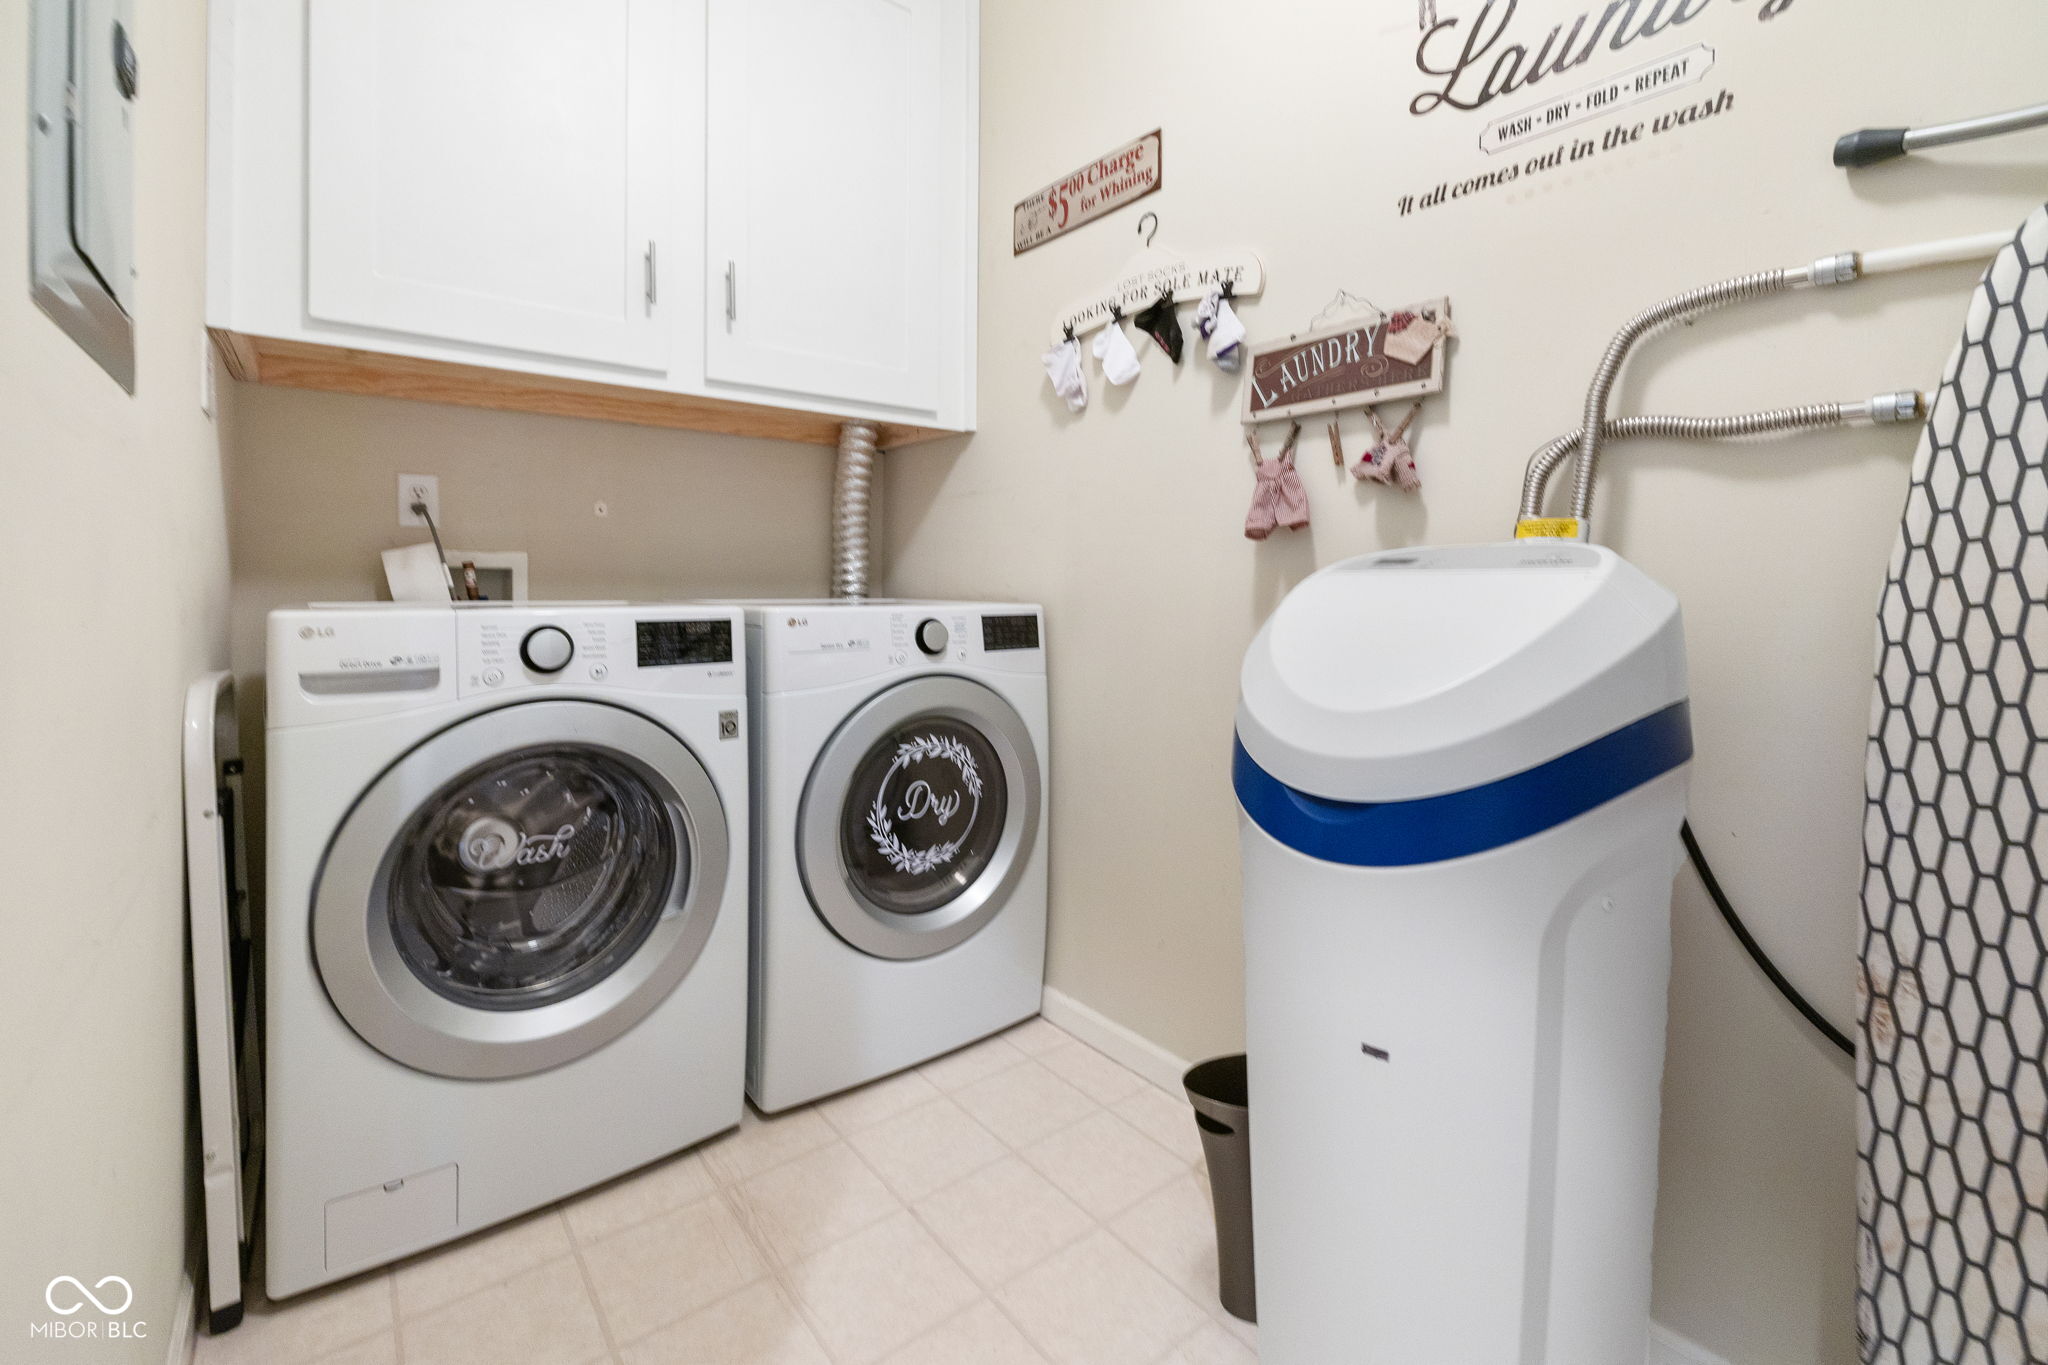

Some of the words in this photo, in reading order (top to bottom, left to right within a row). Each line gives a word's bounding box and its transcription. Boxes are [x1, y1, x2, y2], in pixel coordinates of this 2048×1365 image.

[1498, 117, 1531, 141] WASH
[1546, 103, 1571, 125] DRY
[1586, 85, 1619, 110] FOLD
[1635, 58, 1690, 93] REPEAT
[1087, 144, 1144, 186] Charge
[1398, 194, 1414, 217] It
[1419, 181, 1448, 209] all
[1451, 163, 1519, 199] comes
[1525, 144, 1564, 175] out
[1570, 138, 1595, 162] in
[1602, 121, 1645, 151] the
[1652, 89, 1735, 135] wash
[1081, 195, 1097, 213] for
[1100, 165, 1153, 202] Whining
[1121, 285, 1148, 306] FOR
[1198, 265, 1244, 287] MATE
[1251, 321, 1382, 408] LAUNDRY
[897, 780, 961, 826] Dry
